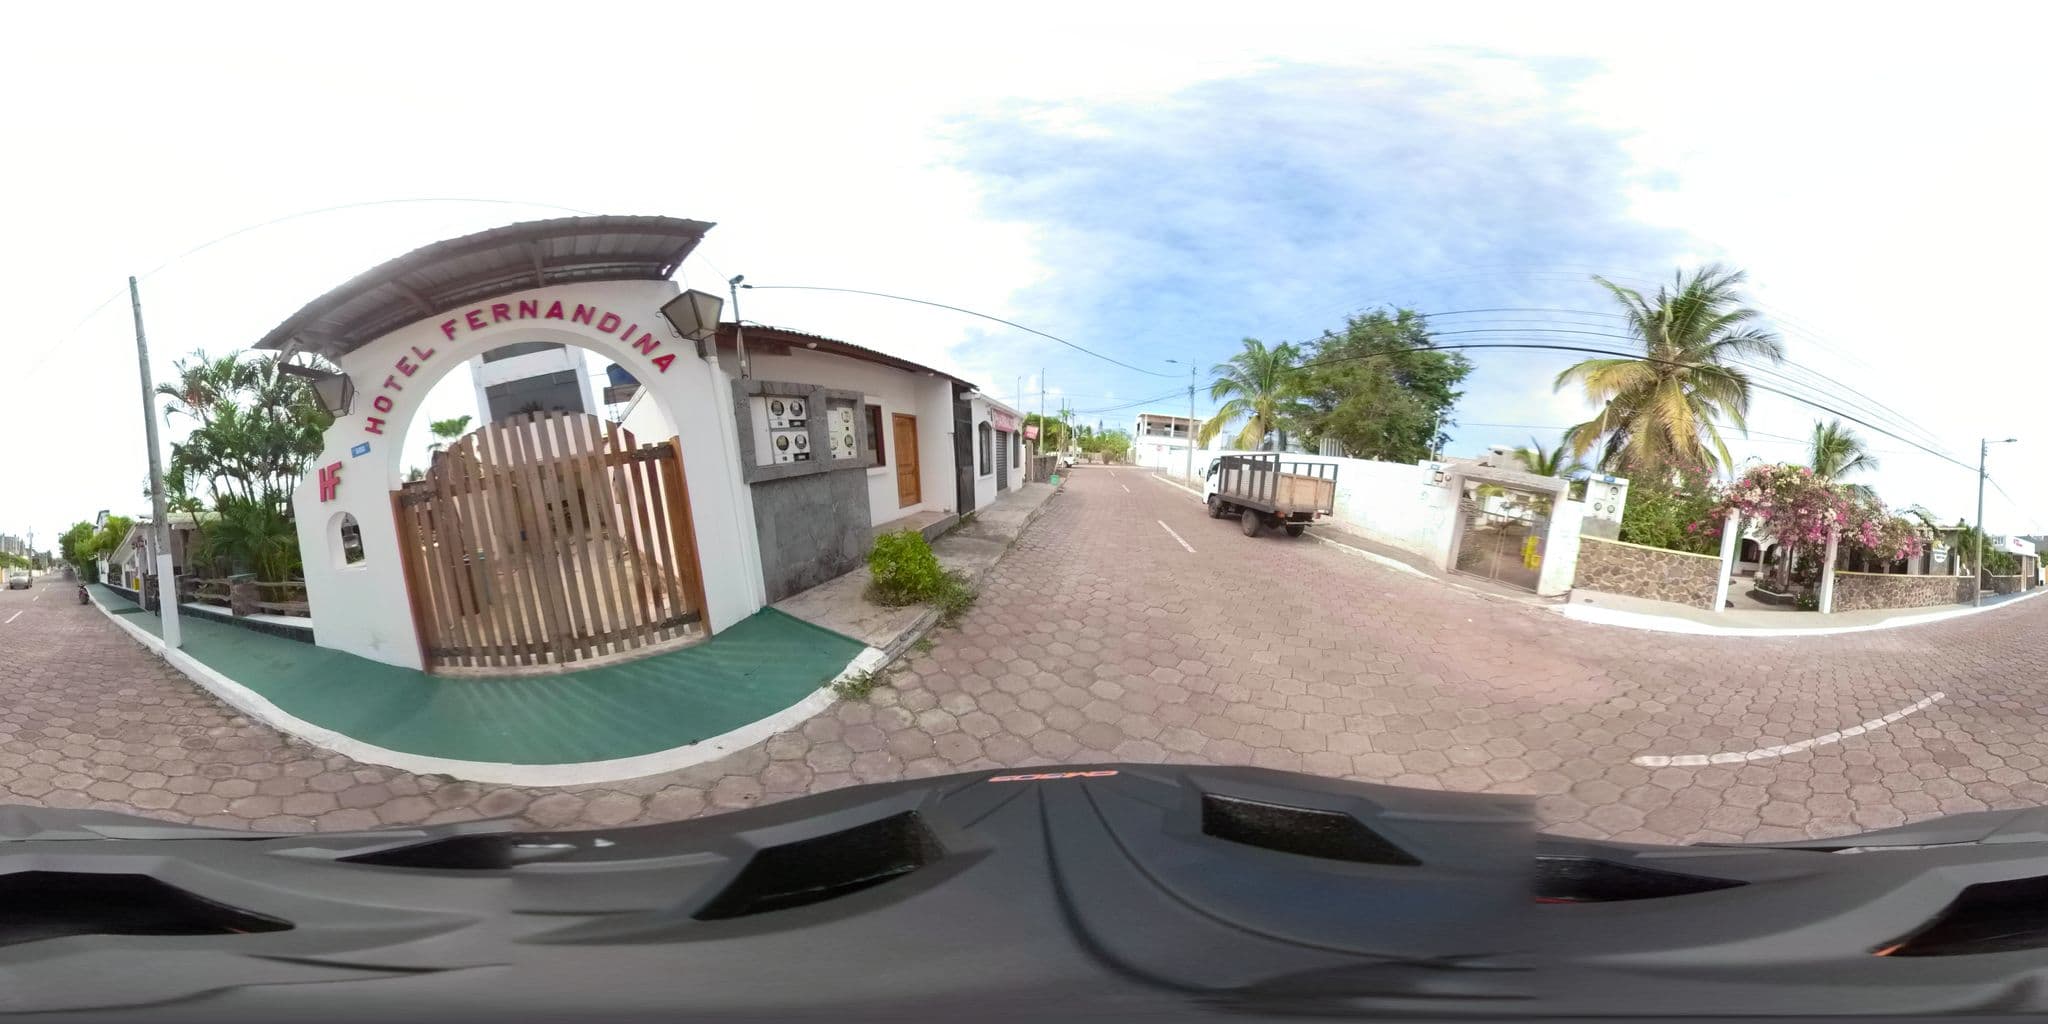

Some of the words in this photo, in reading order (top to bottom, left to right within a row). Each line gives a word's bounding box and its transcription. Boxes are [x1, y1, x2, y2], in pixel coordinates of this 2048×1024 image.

[364, 346, 435, 435] HOTEL
[441, 300, 677, 374] FERNANDINA
[318, 461, 343, 502] HF
